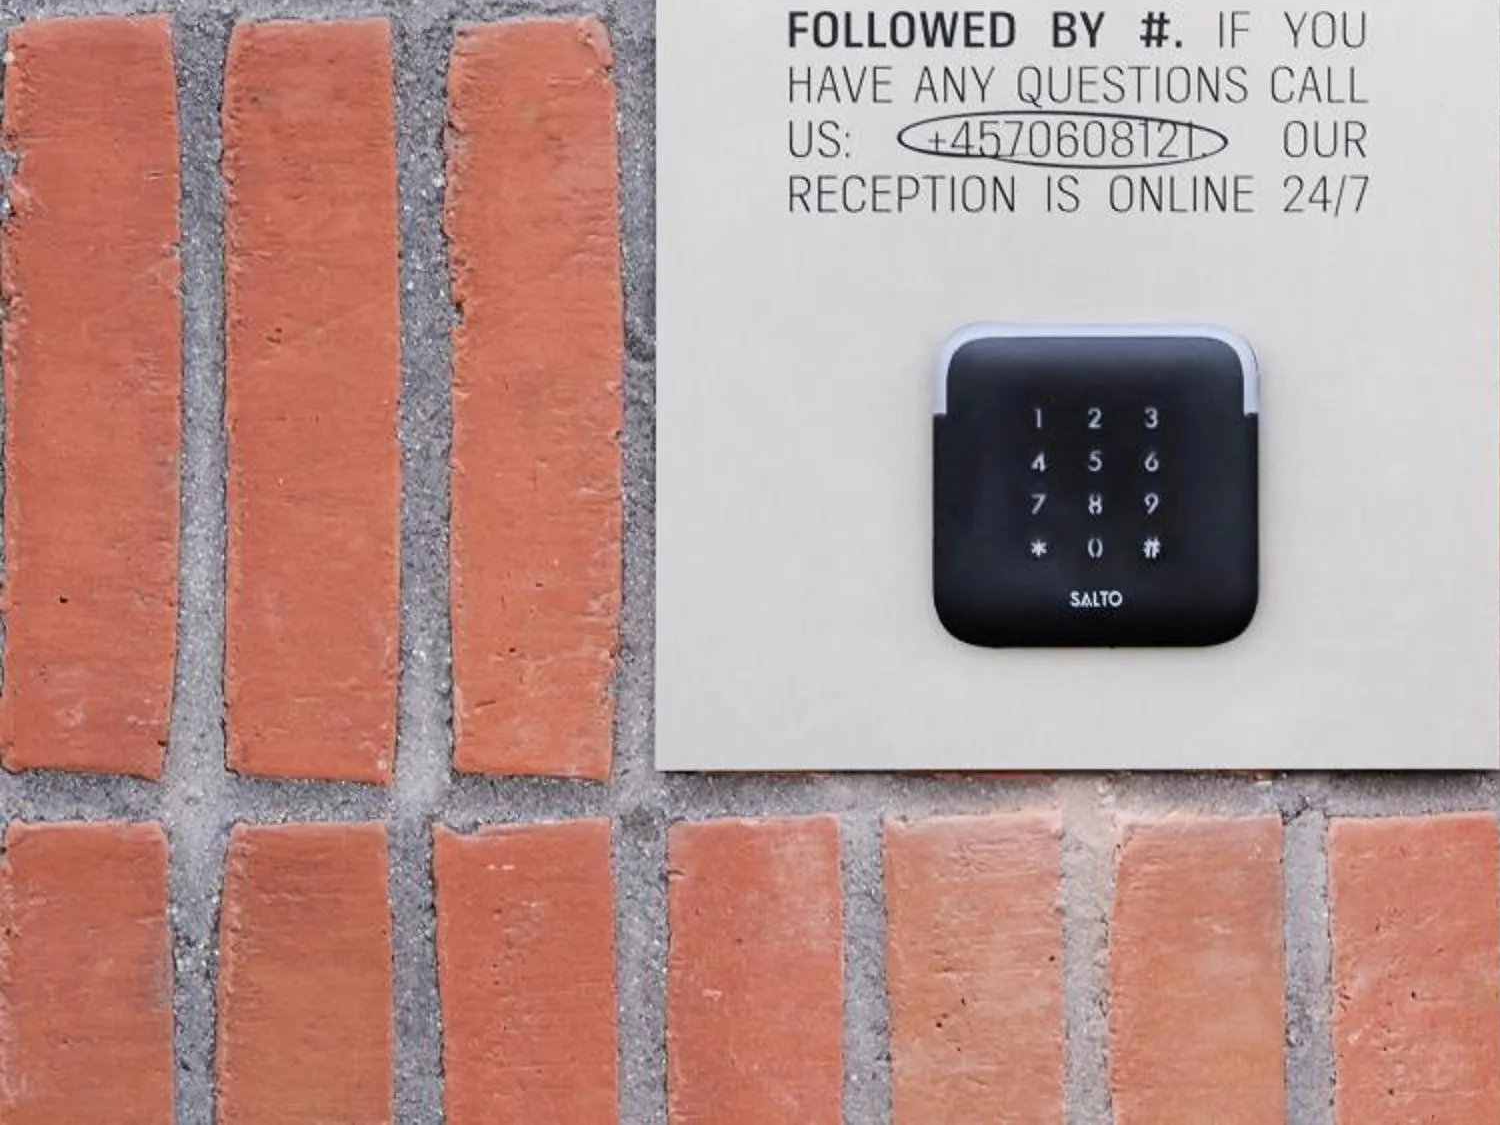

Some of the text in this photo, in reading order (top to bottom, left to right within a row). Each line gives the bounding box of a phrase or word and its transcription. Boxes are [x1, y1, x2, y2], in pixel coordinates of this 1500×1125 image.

[788, 11, 1366, 49] FOLLOWED BY #. IF YOU
[788, 65, 1369, 109] HAVE ANY QUESTIONS CALL
[788, 120, 850, 158] US:
[1283, 120, 1367, 159] OUR
[788, 175, 1369, 217] RECEPTION IS ONLINE 24/7
[1033, 407, 1158, 429] 1 2 3
[1031, 450, 1159, 472] 4 5 6
[1031, 492, 1159, 515] 7 8 9
[1087, 537, 1103, 558] 0
[1143, 537, 1161, 559] #
[1069, 589, 1123, 608] SALTO
